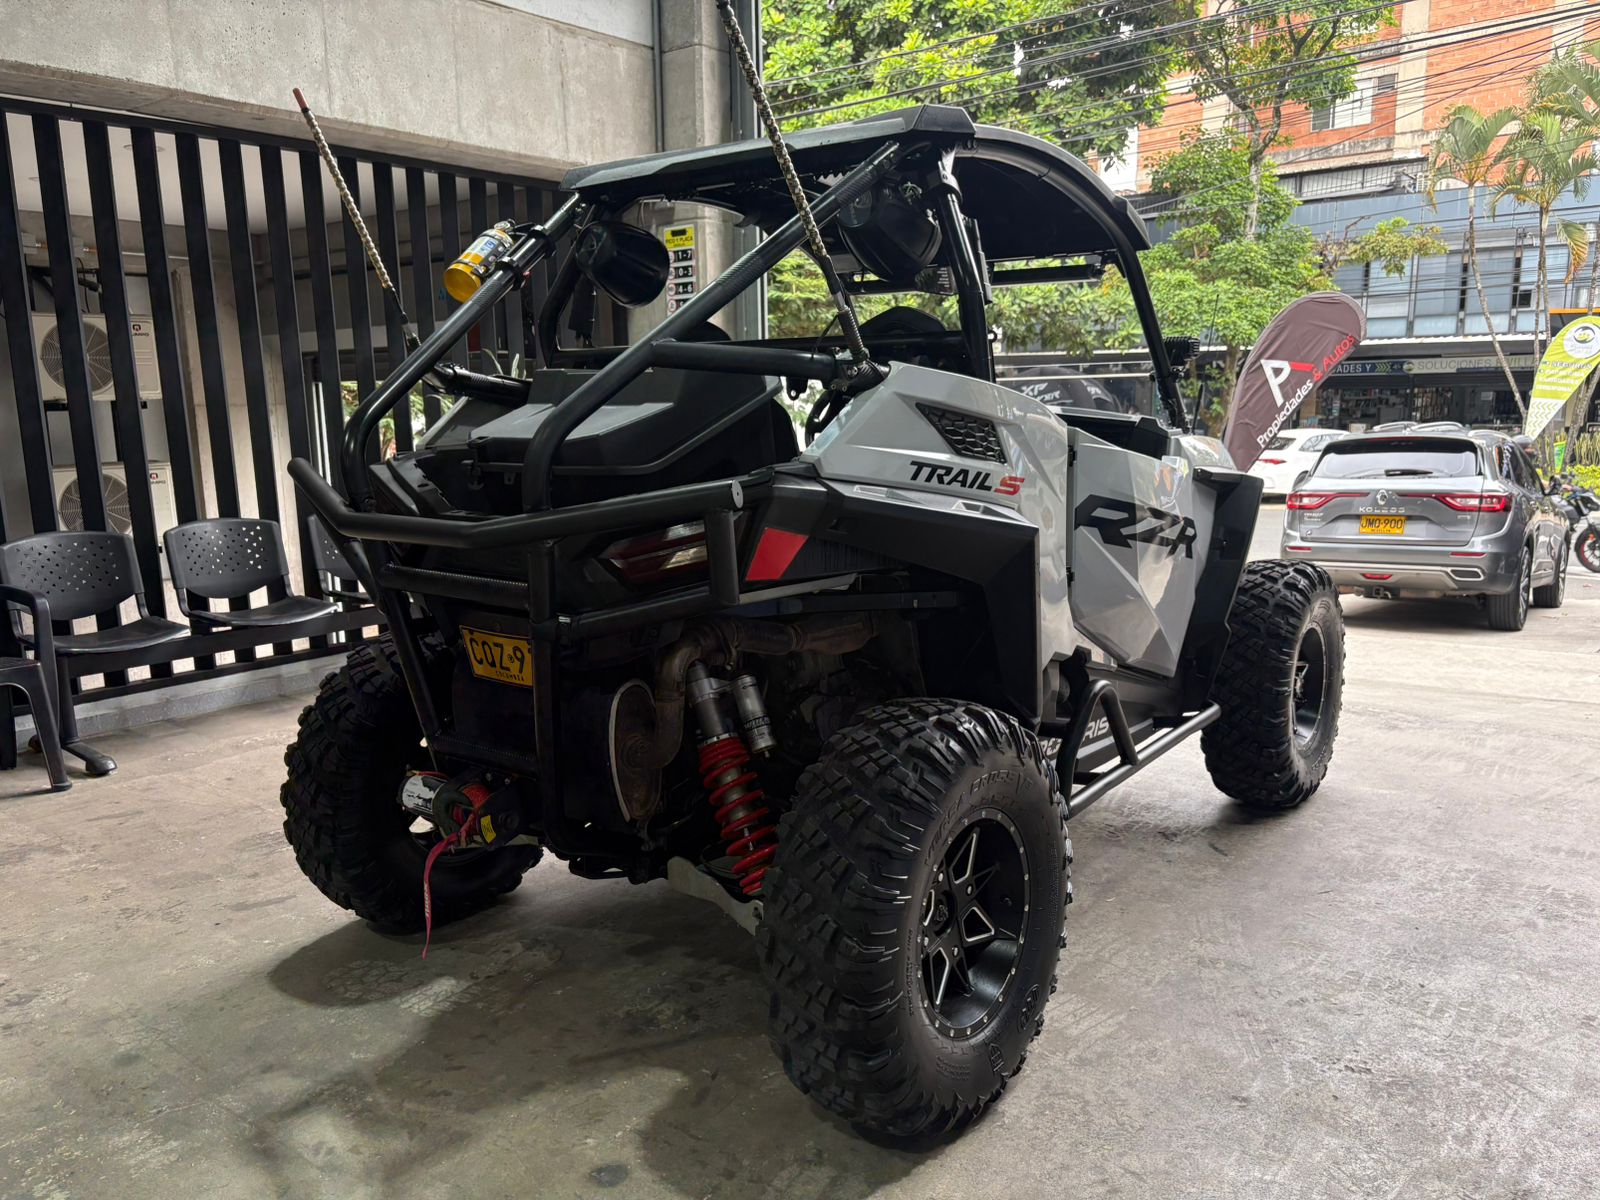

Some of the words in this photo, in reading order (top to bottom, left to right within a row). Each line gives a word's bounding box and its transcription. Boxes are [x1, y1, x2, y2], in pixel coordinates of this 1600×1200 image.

[1335, 364, 1362, 374] ADES
[1365, 363, 1372, 372] Y
[1418, 359, 1492, 371] SOLUCIONES
[1257, 379, 1313, 448] Propiedades
[1312, 366, 1323, 382] &
[1323, 334, 1356, 372] Autos
[909, 460, 992, 492] TRAIL
[994, 475, 1025, 496] S
[1074, 494, 1197, 559] RZR
